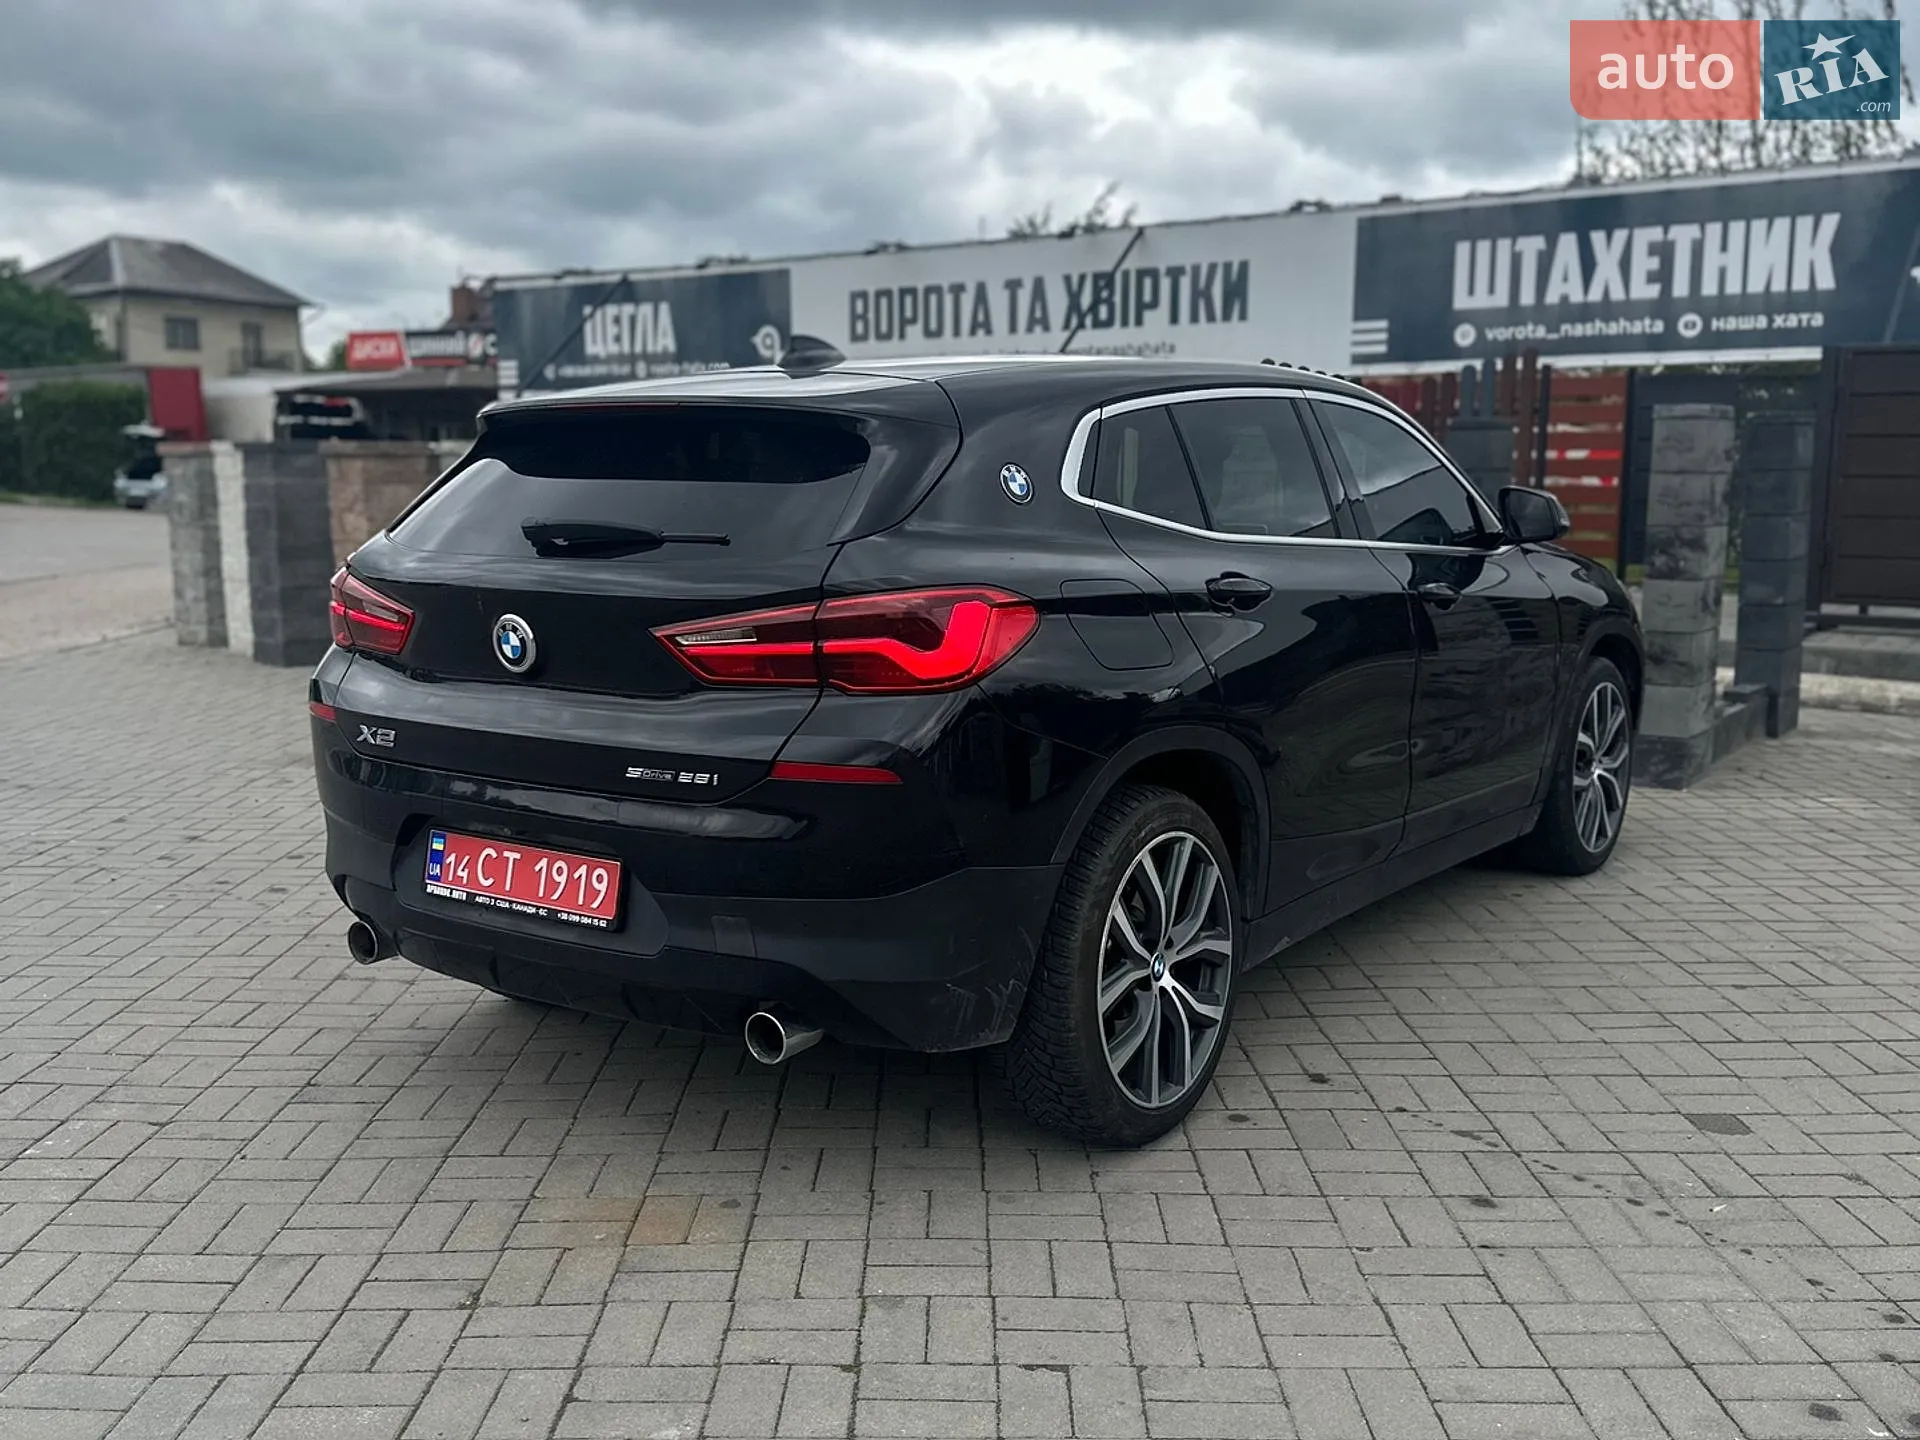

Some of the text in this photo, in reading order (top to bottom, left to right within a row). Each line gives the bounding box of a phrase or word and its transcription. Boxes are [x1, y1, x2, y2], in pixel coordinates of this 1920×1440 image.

[1452, 213, 1841, 311] ШТАХЕТНИК
[849, 259, 1250, 344] ВОРОТА ТА ХВІРТКИ
[582, 301, 677, 357] ЦЕГЛА
[1485, 317, 1665, 341] vorota_nashahata
[1711, 312, 1824, 331] наша хата
[356, 724, 396, 747] X2
[429, 863, 441, 877] UA
[533, 857, 609, 910] 1919
